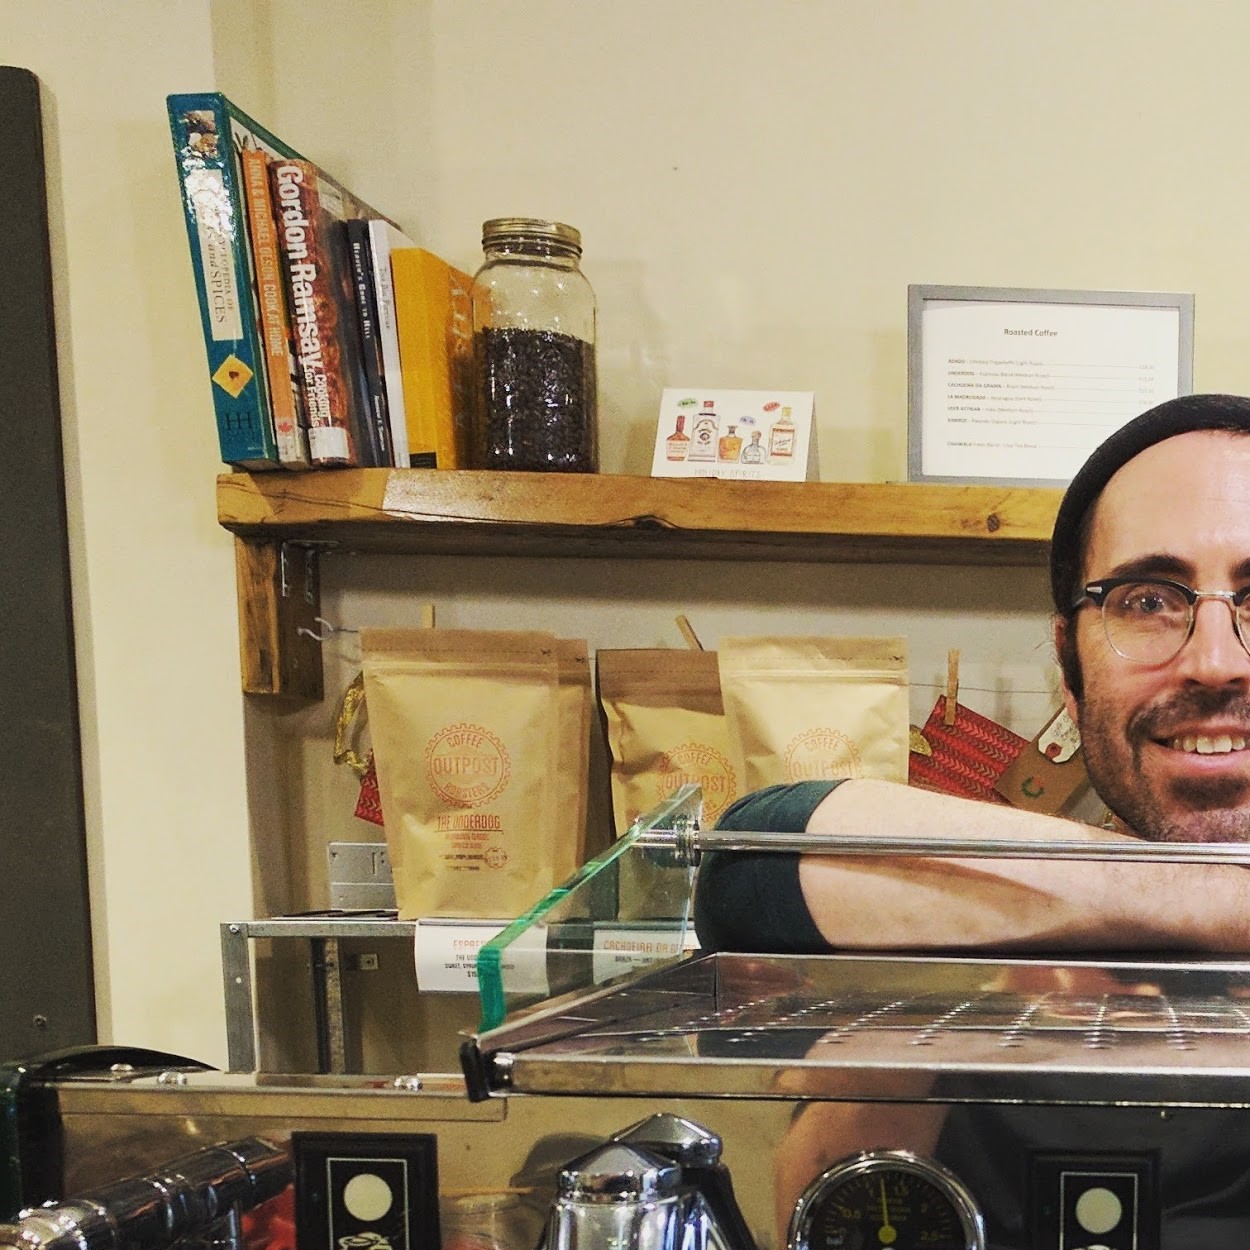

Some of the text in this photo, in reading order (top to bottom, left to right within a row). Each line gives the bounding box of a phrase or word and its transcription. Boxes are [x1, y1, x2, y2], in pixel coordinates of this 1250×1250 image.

[252, 197, 271, 244] MICHAEL
[216, 224, 234, 294] CYCLOPEDIA
[258, 246, 275, 282] OLSON
[276, 165, 323, 368] Gordon Ramsay
[207, 243, 226, 324] and SPICES
[263, 283, 279, 311] COOK
[268, 327, 284, 357] HOME
[1004, 328, 1058, 337] Roasted Coffee
[303, 367, 321, 428] for Friends
[315, 373, 330, 418] Cooking
[447, 733, 483, 748] COFFEE
[804, 737, 841, 752] COFFEE
[433, 755, 498, 775] OUTPOST
[678, 752, 713, 766] COFFEE
[792, 761, 852, 778] OUTPOST
[443, 782, 490, 799] ROASTERS
[437, 814, 500, 830] THE UNDERDOG
